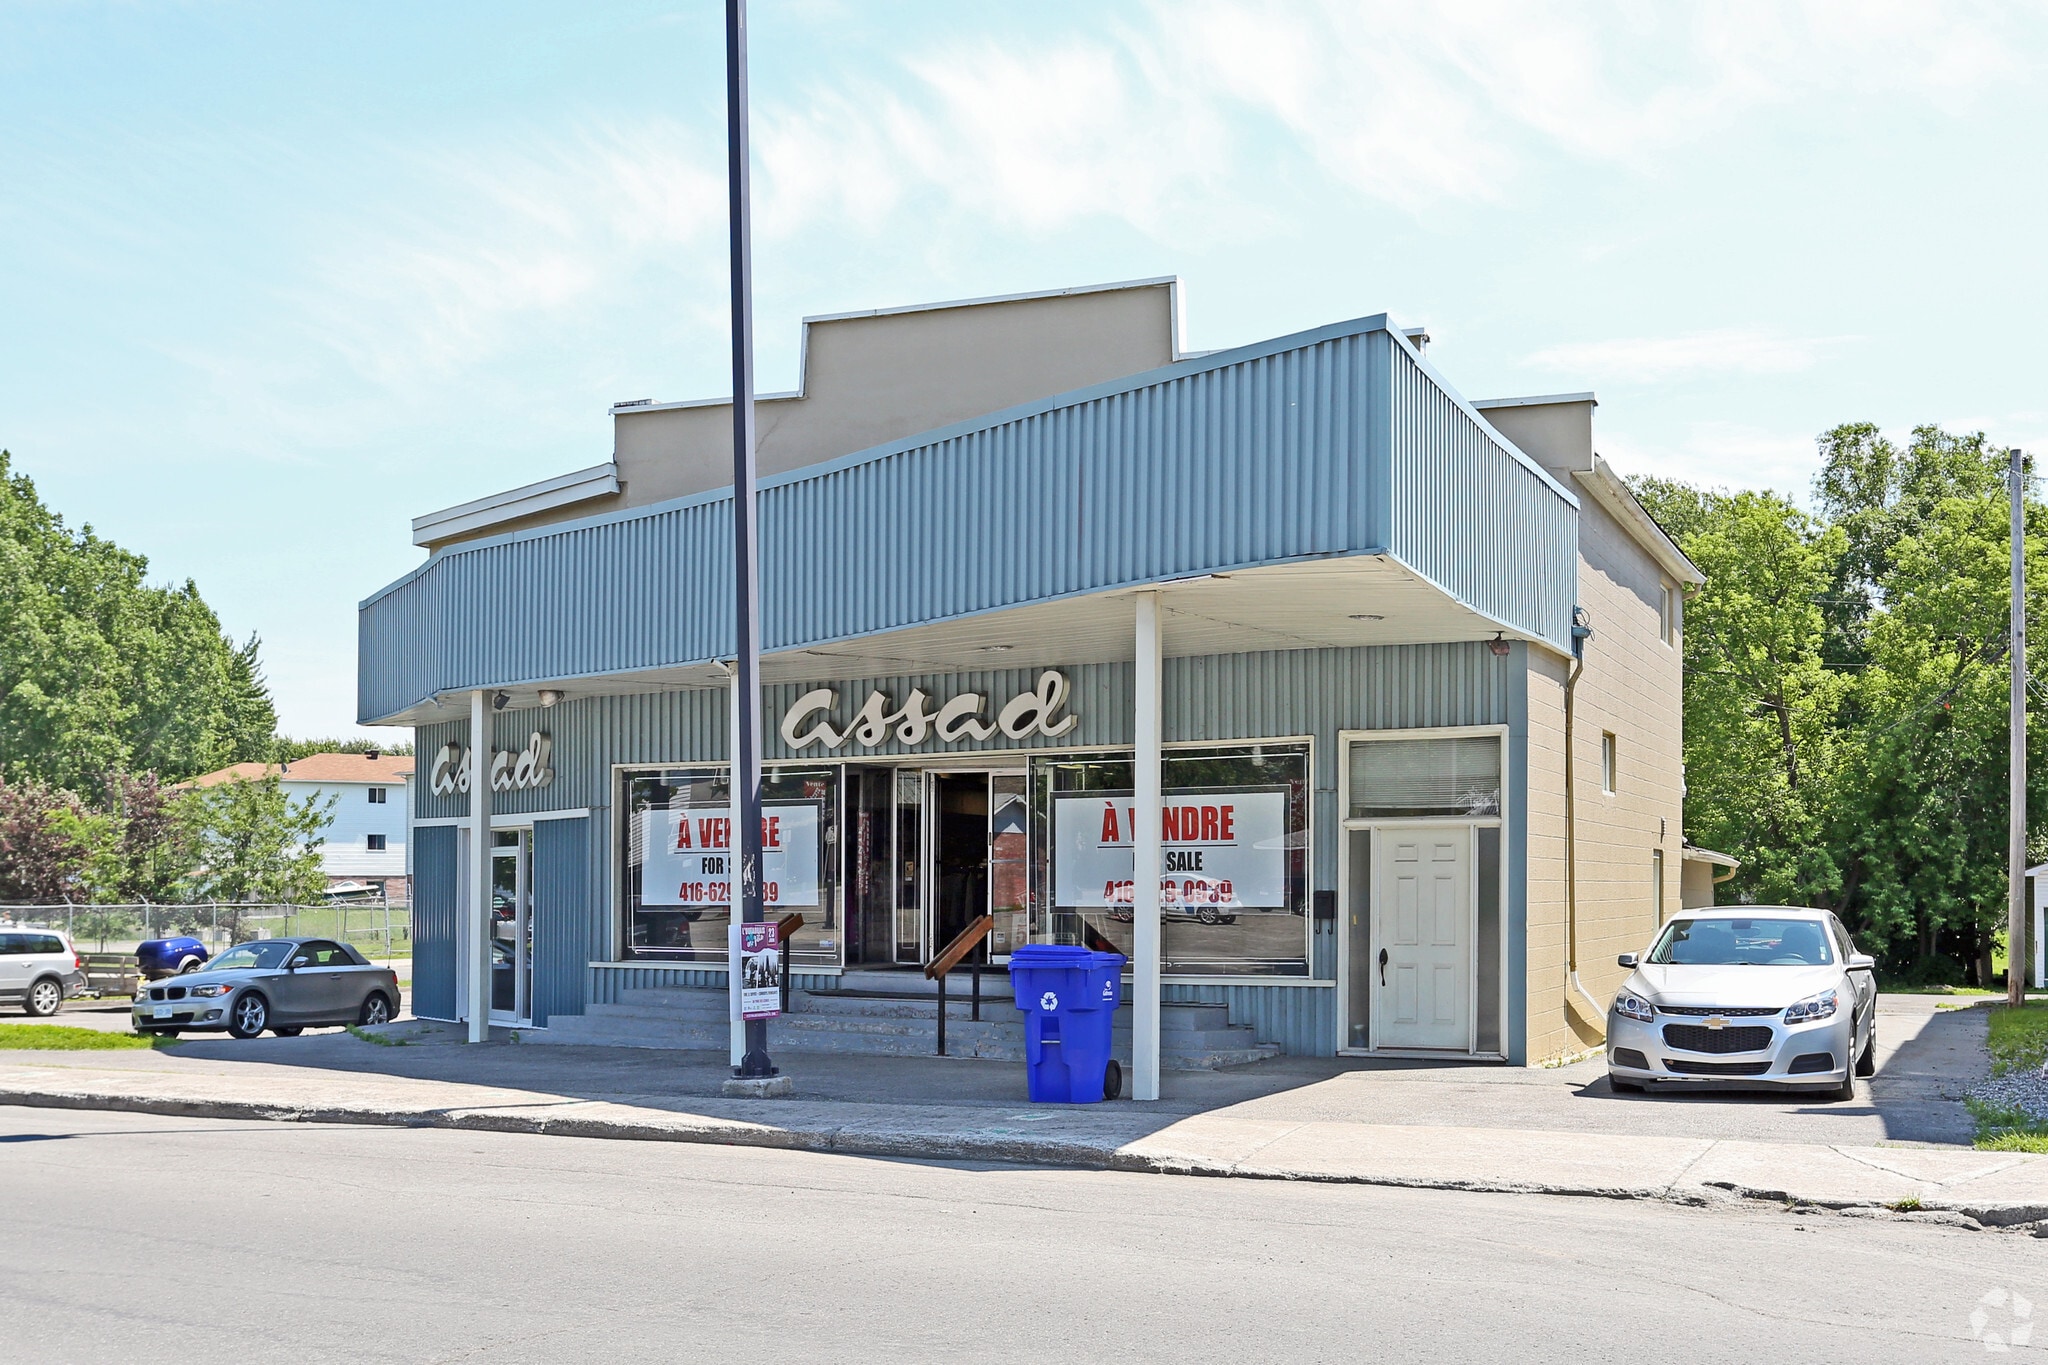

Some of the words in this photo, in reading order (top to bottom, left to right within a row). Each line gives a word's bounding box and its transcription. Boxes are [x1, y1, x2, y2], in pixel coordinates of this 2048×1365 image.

[781, 670, 1077, 750] assad
[431, 731, 553, 796] asad
[677, 813, 691, 848] À
[1101, 801, 1119, 842] À
[1128, 805, 1235, 842] NDRE
[702, 857, 724, 875] FOR
[1166, 851, 1203, 872] SALE
